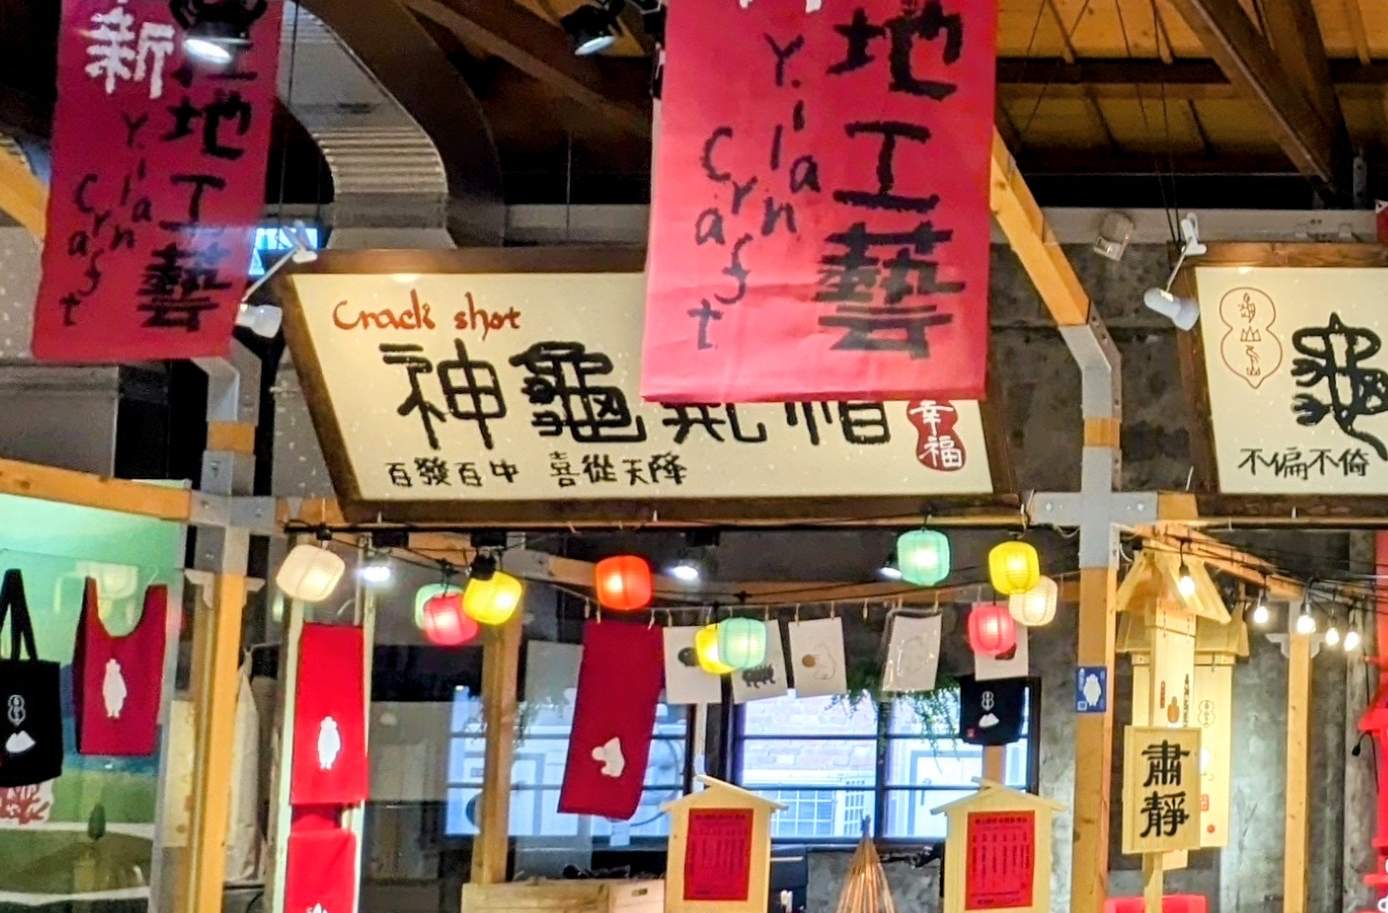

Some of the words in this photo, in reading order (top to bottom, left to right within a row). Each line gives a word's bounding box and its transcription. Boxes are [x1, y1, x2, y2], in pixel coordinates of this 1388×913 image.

[84, 6, 175, 98] 新
[332, 290, 437, 332] Crack
[453, 291, 522, 341] shot
[910, 400, 963, 468] 幸福
[385, 456, 520, 489] 百發百中
[548, 451, 689, 488] 喜從天降
[1237, 446, 1370, 482] 不偏不倚
[1139, 739, 1191, 838] 肅靜
